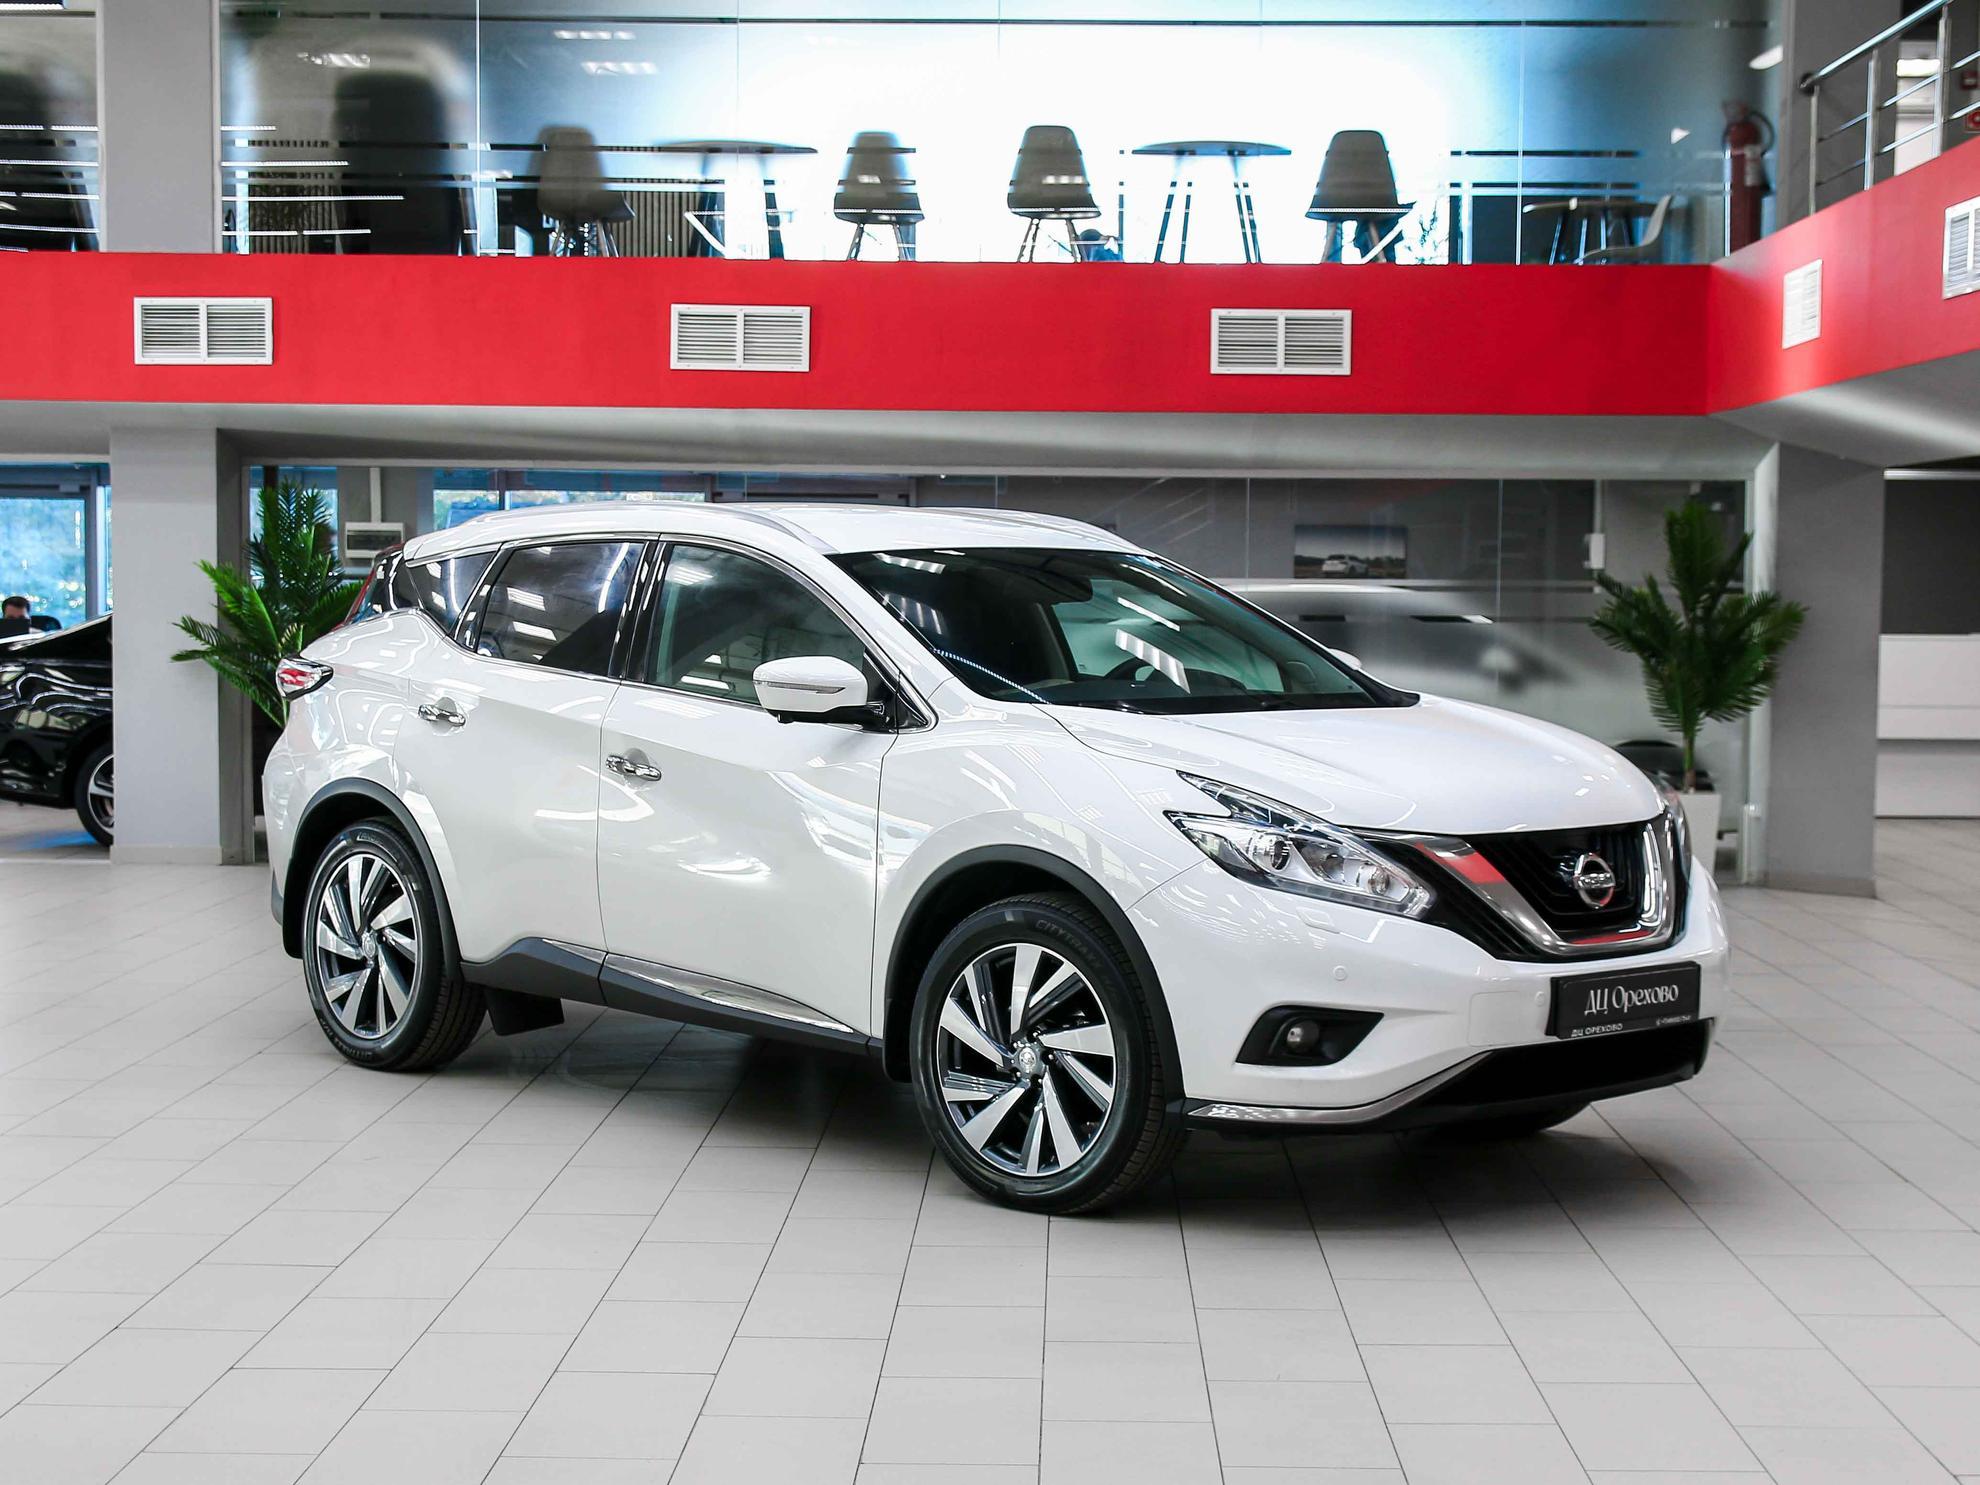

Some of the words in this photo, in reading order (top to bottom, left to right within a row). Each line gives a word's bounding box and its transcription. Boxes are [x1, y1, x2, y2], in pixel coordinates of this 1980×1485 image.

[1584, 987, 1608, 1016] ДЦ
[1611, 984, 1679, 1013] Орехово
[1585, 1023, 1623, 1035] ОРЕХОВО
